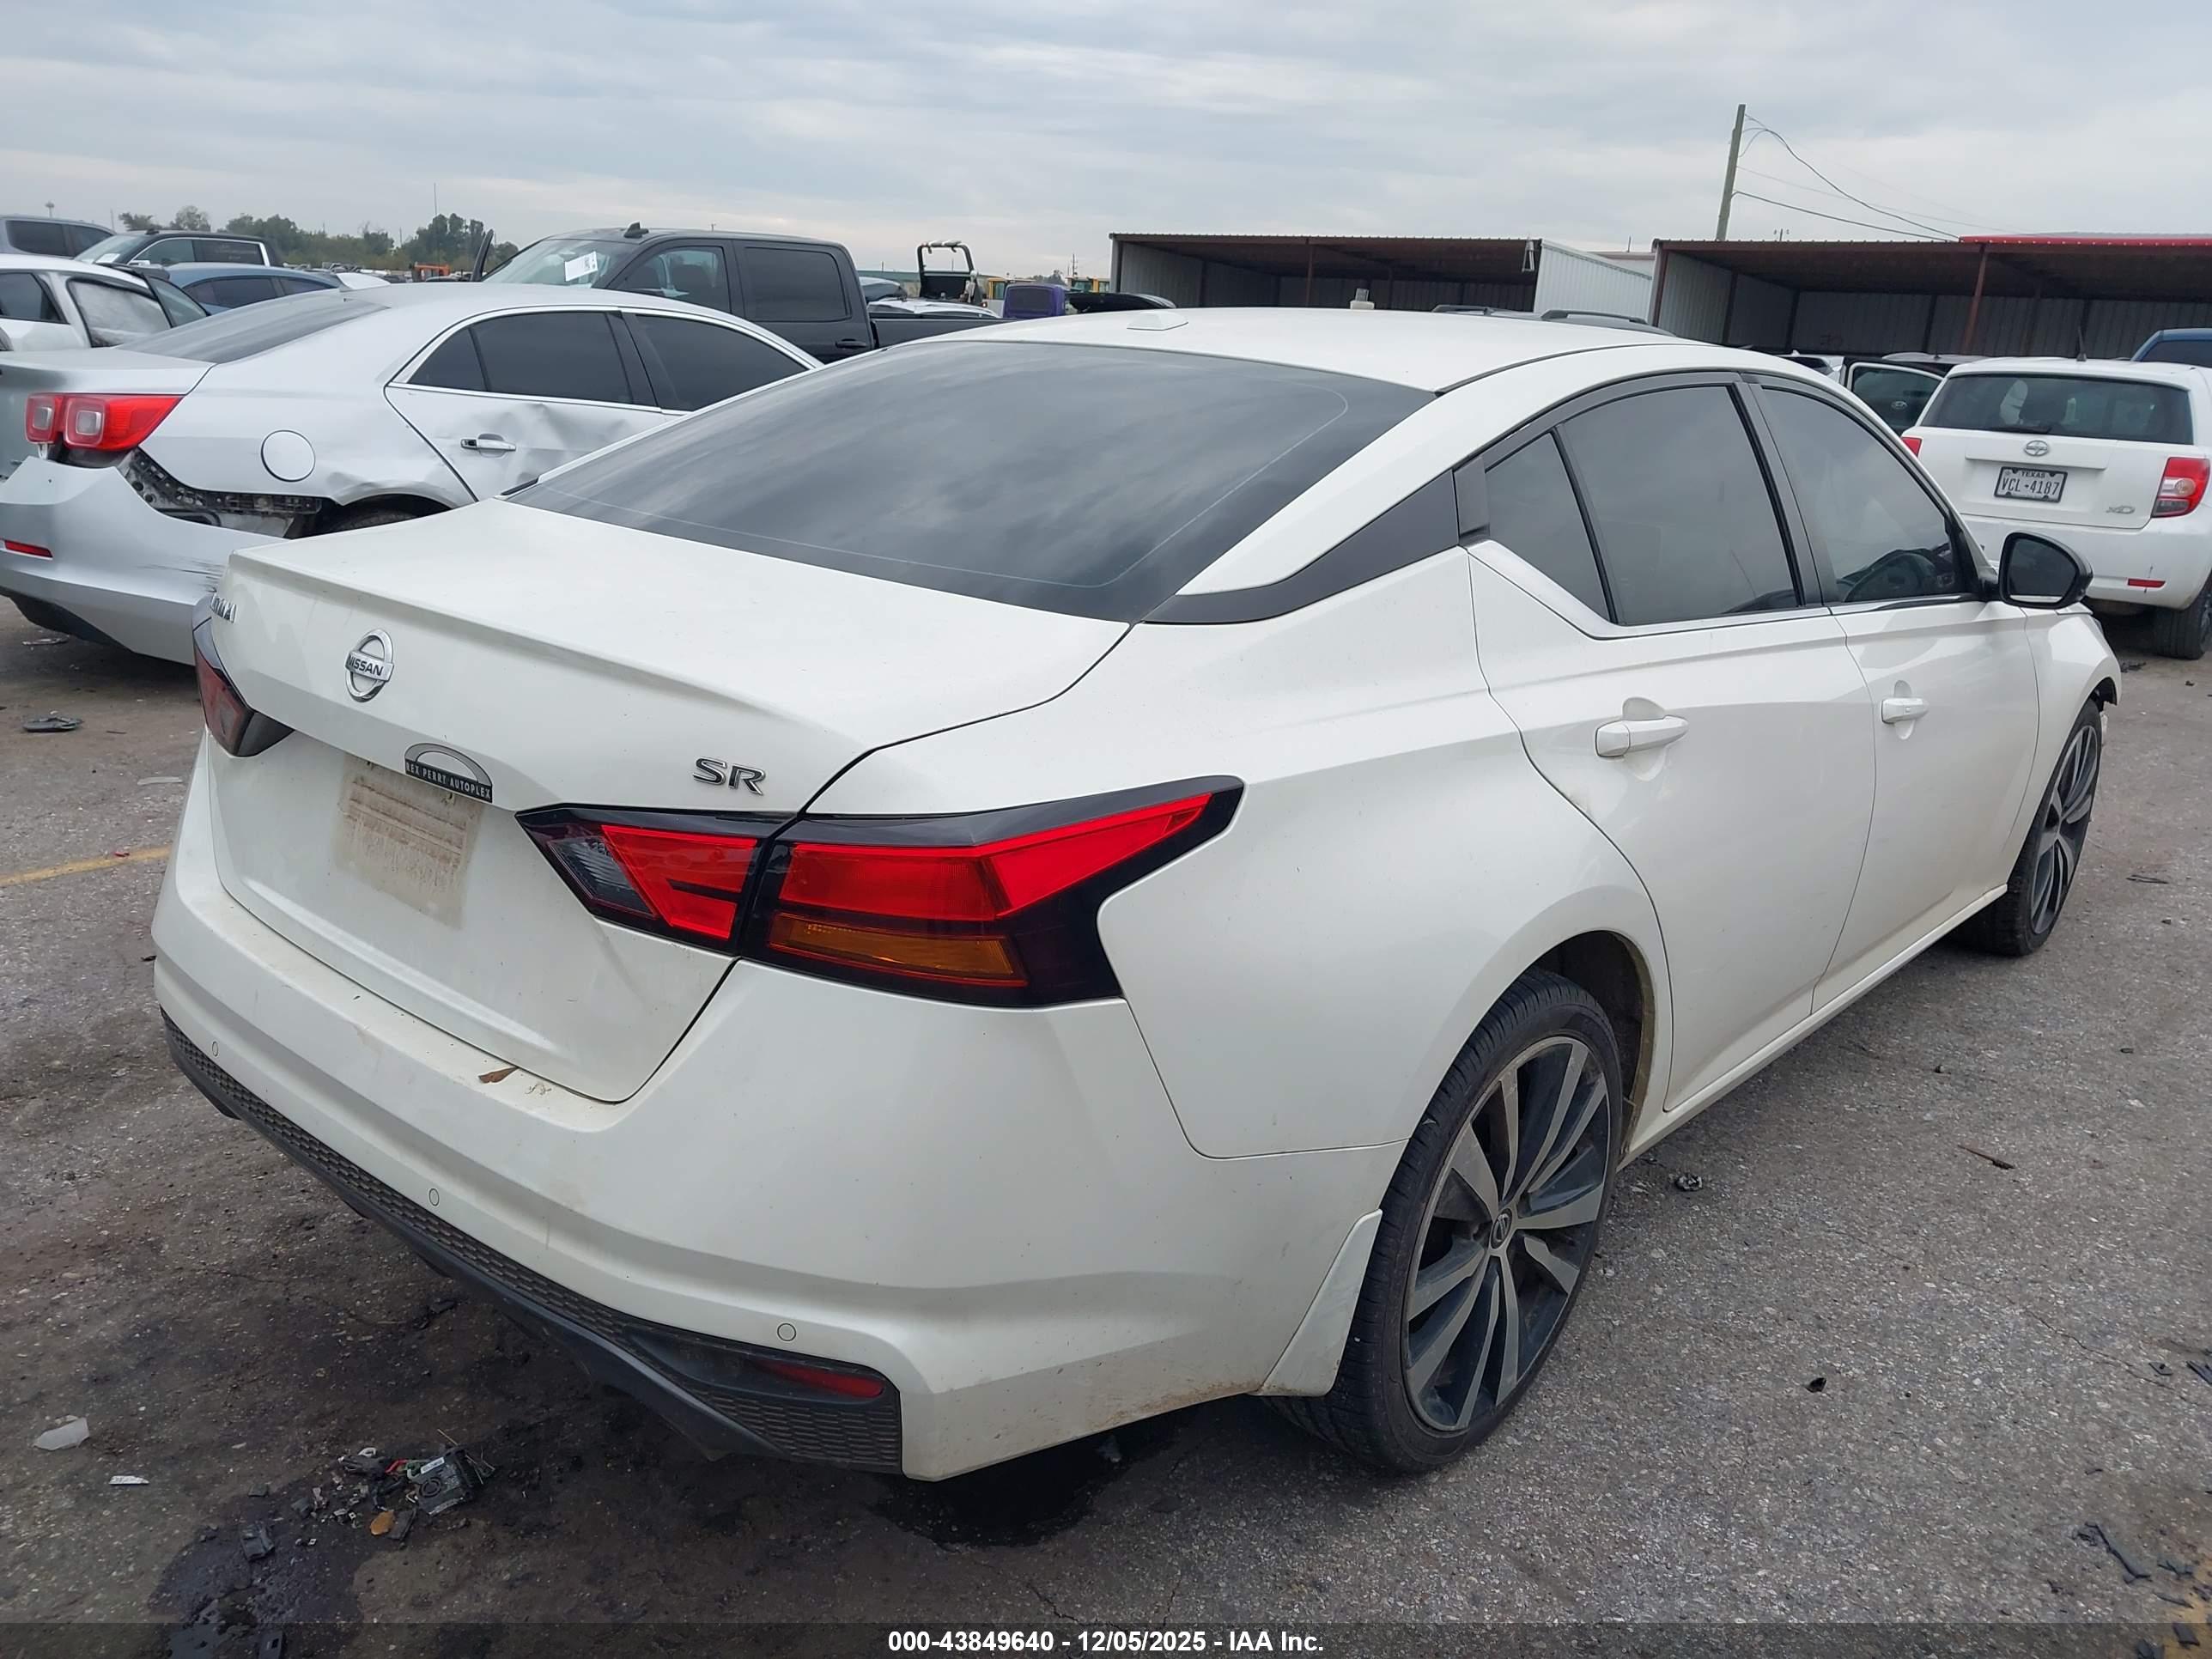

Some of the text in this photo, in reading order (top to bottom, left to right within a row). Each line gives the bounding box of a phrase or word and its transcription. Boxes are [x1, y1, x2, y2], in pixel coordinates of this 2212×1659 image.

[347, 655, 384, 677] NISSAN
[450, 777, 490, 799] AUTOPLEX
[692, 757, 766, 797] SR
